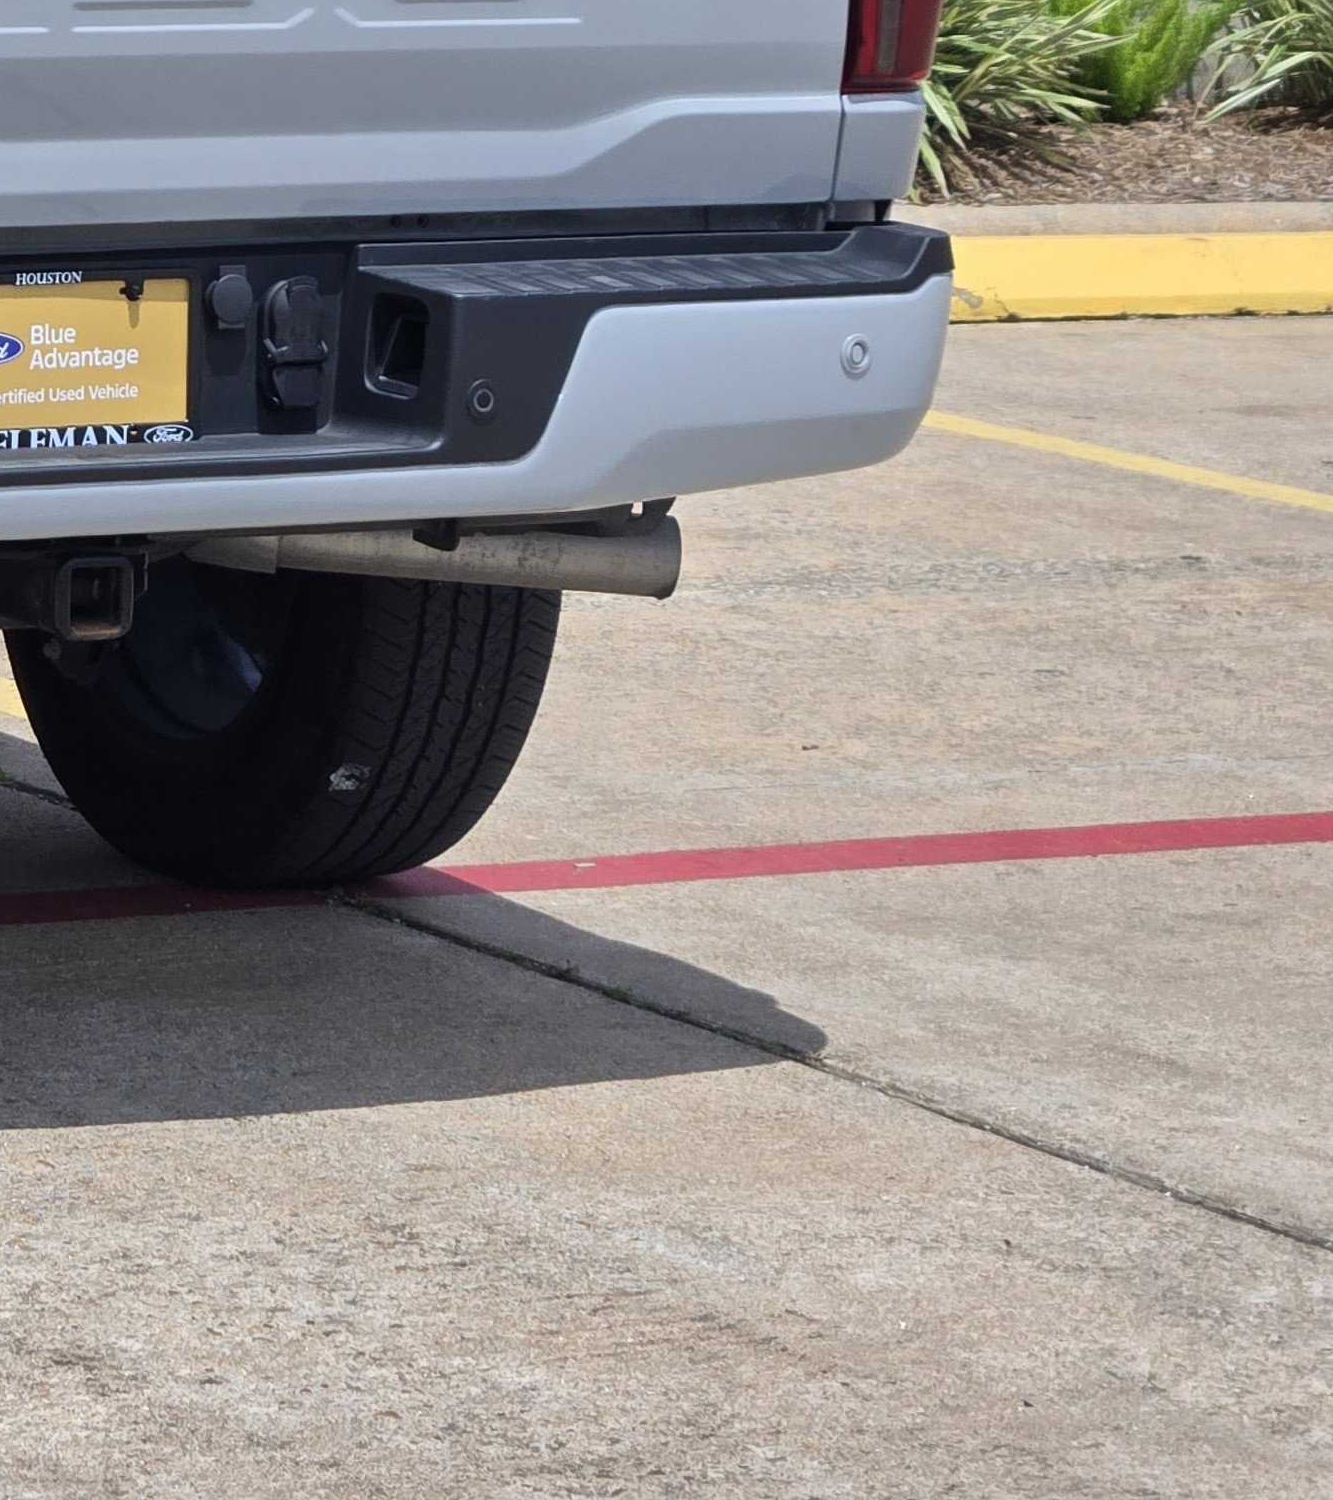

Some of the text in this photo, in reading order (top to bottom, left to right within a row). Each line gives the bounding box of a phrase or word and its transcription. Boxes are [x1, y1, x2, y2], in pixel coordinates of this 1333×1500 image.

[15, 271, 83, 286] HOUSTON
[30, 323, 76, 346] Blue
[29, 347, 139, 370] Advantage
[49, 385, 84, 402] Used
[89, 383, 139, 400] Vehicle
